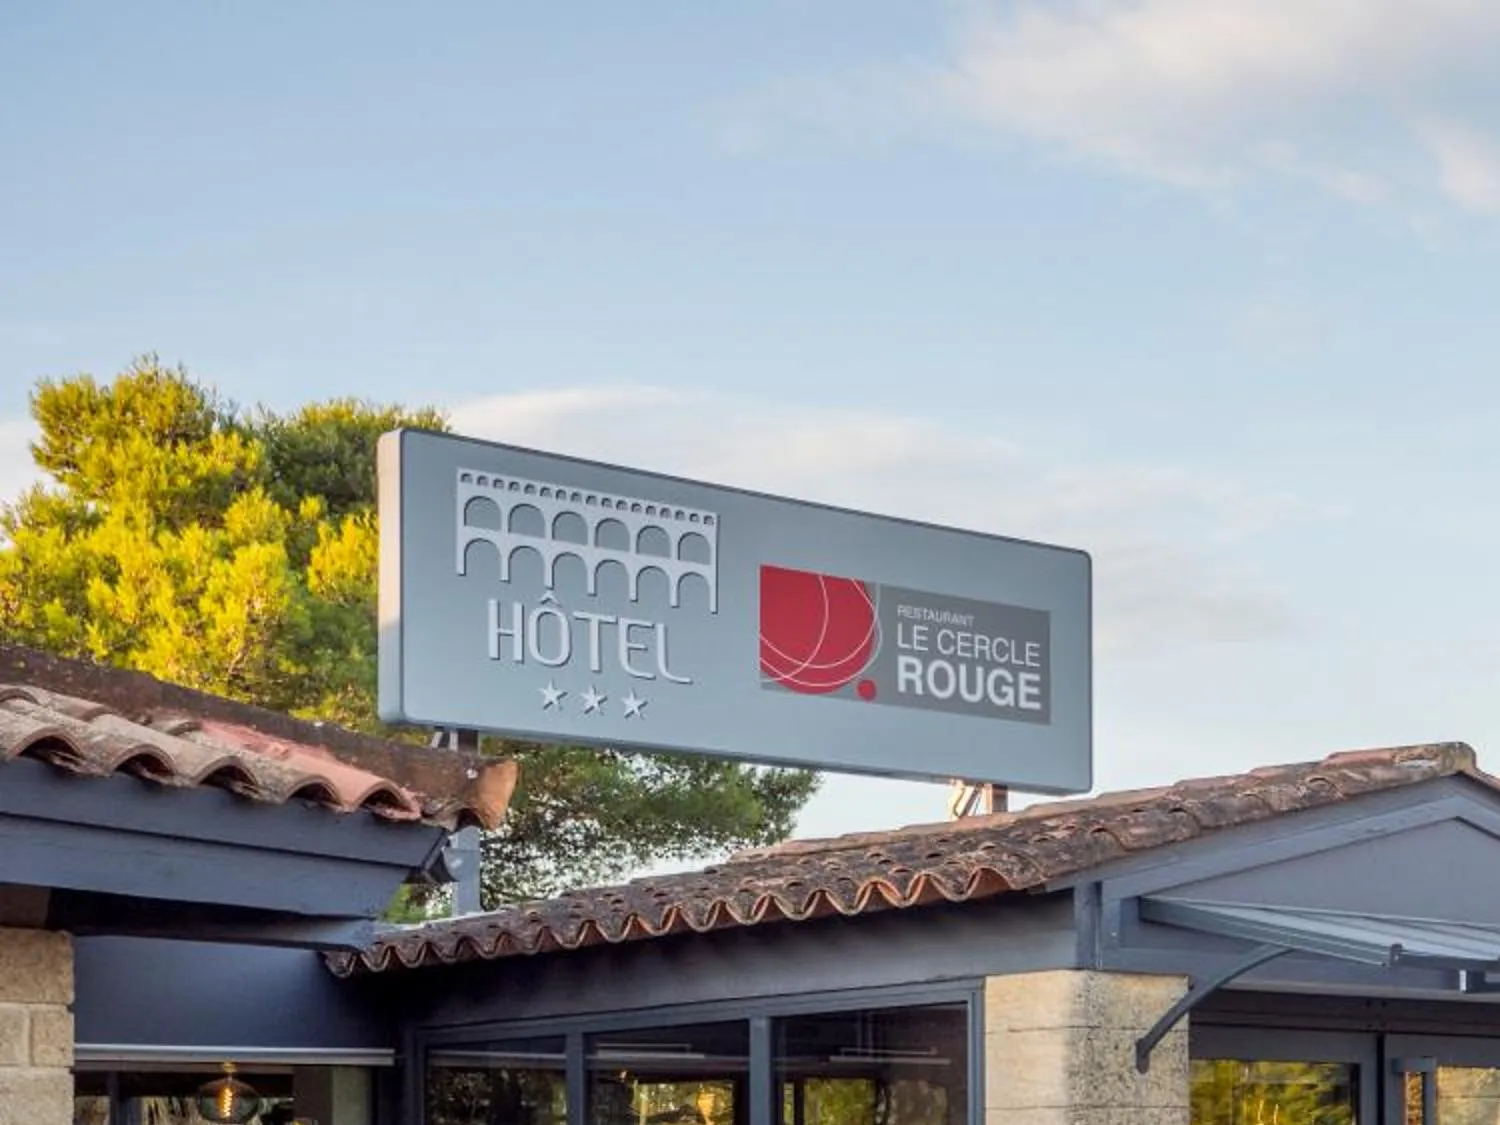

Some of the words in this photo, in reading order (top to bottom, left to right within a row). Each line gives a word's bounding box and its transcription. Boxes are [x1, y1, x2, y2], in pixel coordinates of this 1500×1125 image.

[488, 590, 693, 684] HÔTEL
[897, 604, 976, 627] RESTAURANT
[897, 623, 929, 651] LE
[937, 628, 1041, 667] CERCLE
[897, 655, 1042, 710] ROUGE
